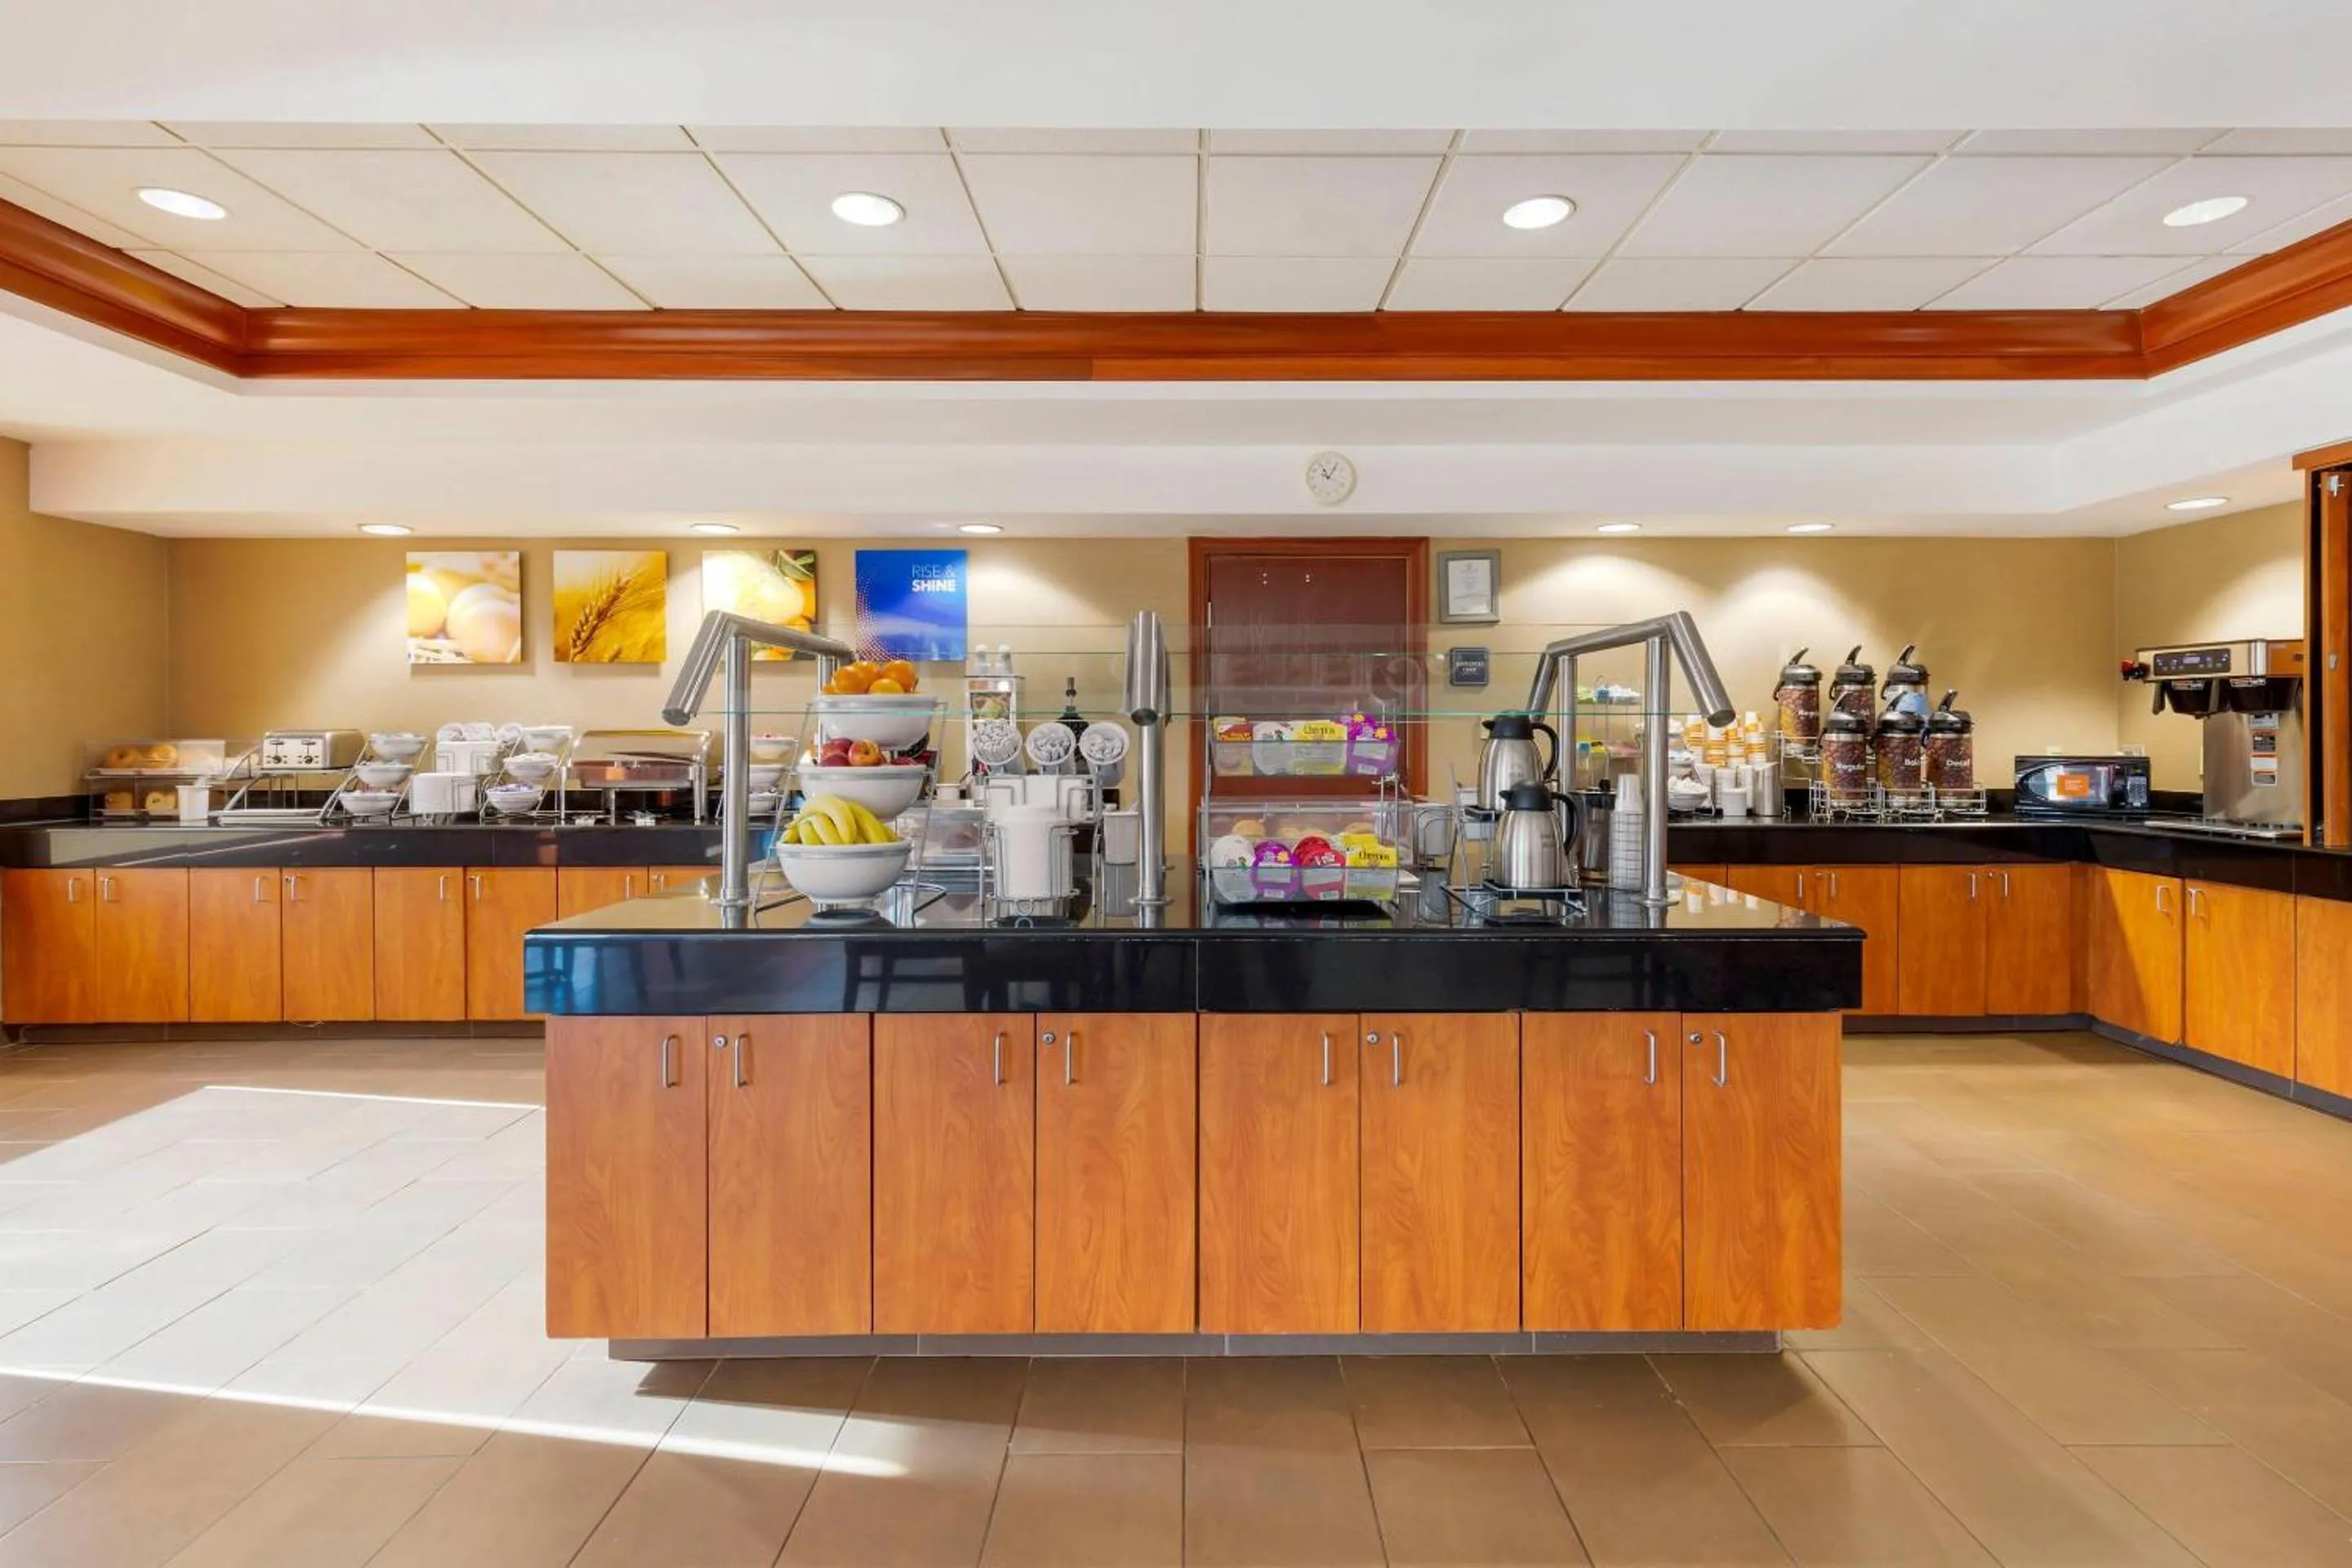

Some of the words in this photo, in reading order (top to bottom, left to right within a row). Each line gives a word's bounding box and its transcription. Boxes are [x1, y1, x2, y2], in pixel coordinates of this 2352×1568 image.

[911, 564, 942, 578] RISE
[943, 564, 955, 578] &
[911, 579, 956, 592] SHINE
